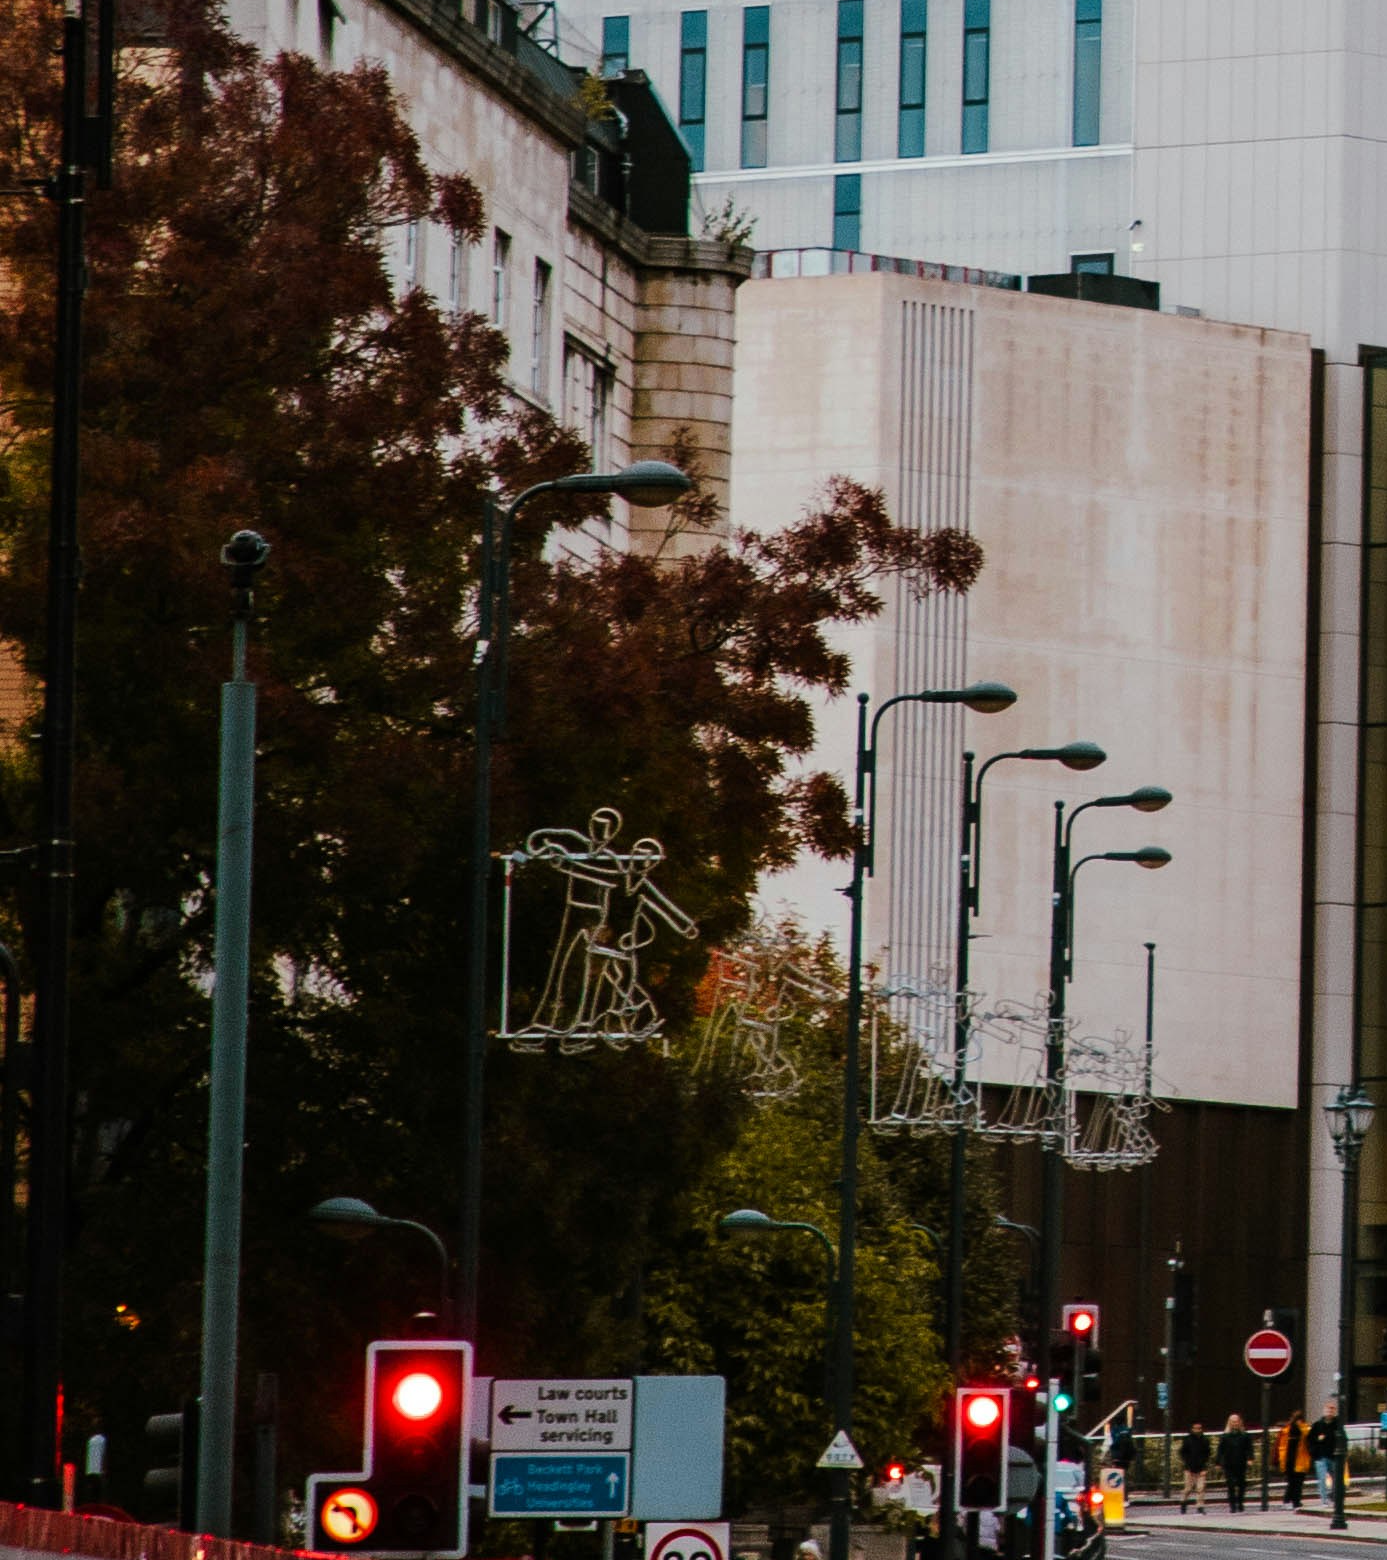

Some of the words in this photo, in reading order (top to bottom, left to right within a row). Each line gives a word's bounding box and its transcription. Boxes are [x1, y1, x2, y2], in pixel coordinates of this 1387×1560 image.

[537, 1387, 569, 1401] Law
[575, 1386, 628, 1401] courts
[537, 1409, 579, 1424] Town
[585, 1409, 618, 1424] Hall
[540, 1429, 614, 1444] servicing
